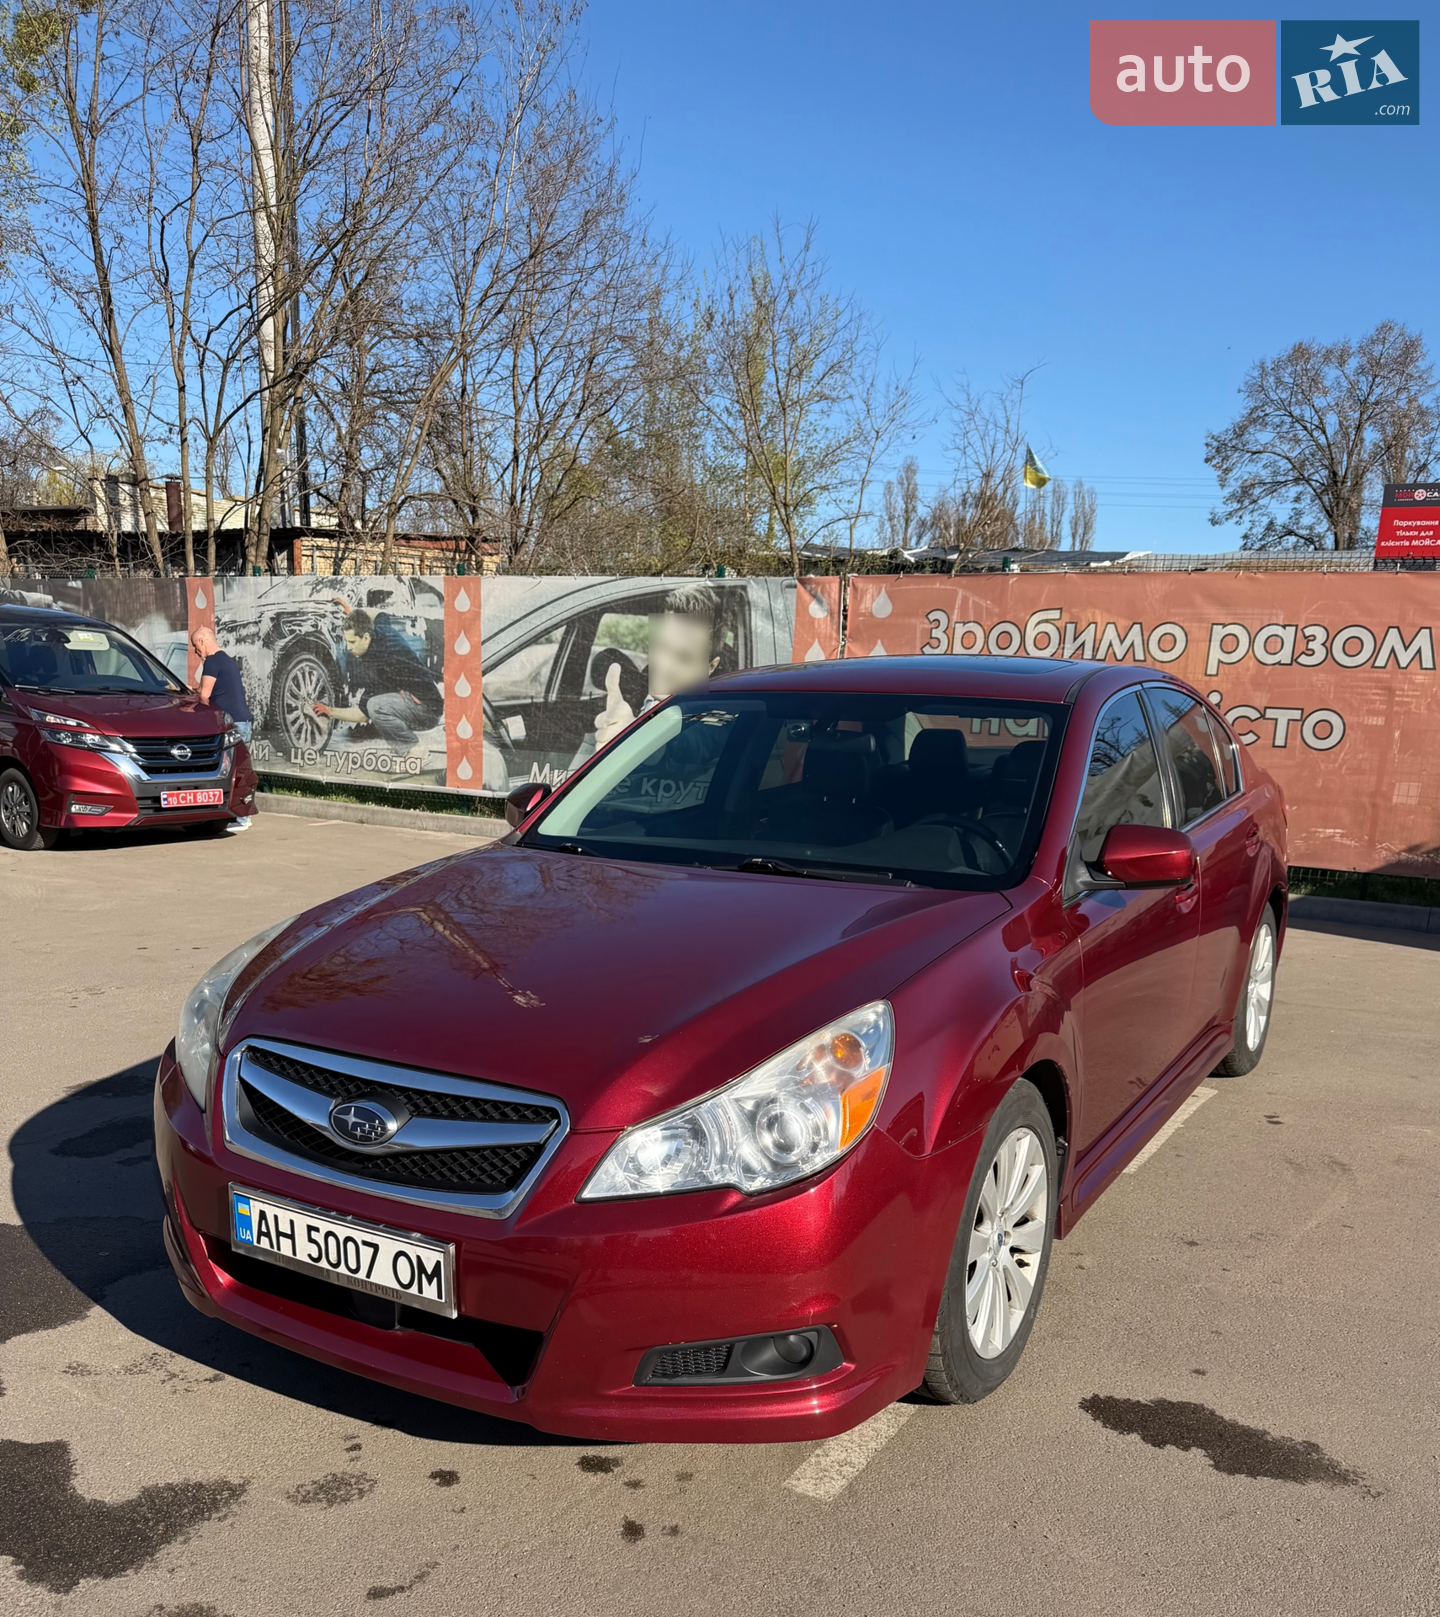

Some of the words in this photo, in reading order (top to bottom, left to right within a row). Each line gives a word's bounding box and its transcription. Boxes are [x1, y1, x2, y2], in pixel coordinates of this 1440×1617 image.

[1393, 519, 1439, 527] Паркування
[1396, 529, 1419, 537] тільки
[1381, 539, 1410, 547] клієнтів
[920, 607, 1188, 663] Зробимо
[1204, 622, 1437, 676] разом
[290, 746, 317, 767] це
[323, 748, 422, 775] турбота
[528, 761, 569, 788] Ми
[641, 777, 713, 803] крут
[168, 797, 177, 805] 10
[179, 792, 193, 803] CH
[196, 791, 219, 802] 8037
[239, 1226, 253, 1242] UA
[256, 1209, 298, 1257] AH
[306, 1223, 380, 1279] 5007
[392, 1250, 443, 1300] OM
[346, 1275, 402, 1301] КОНТРОЛЬ
